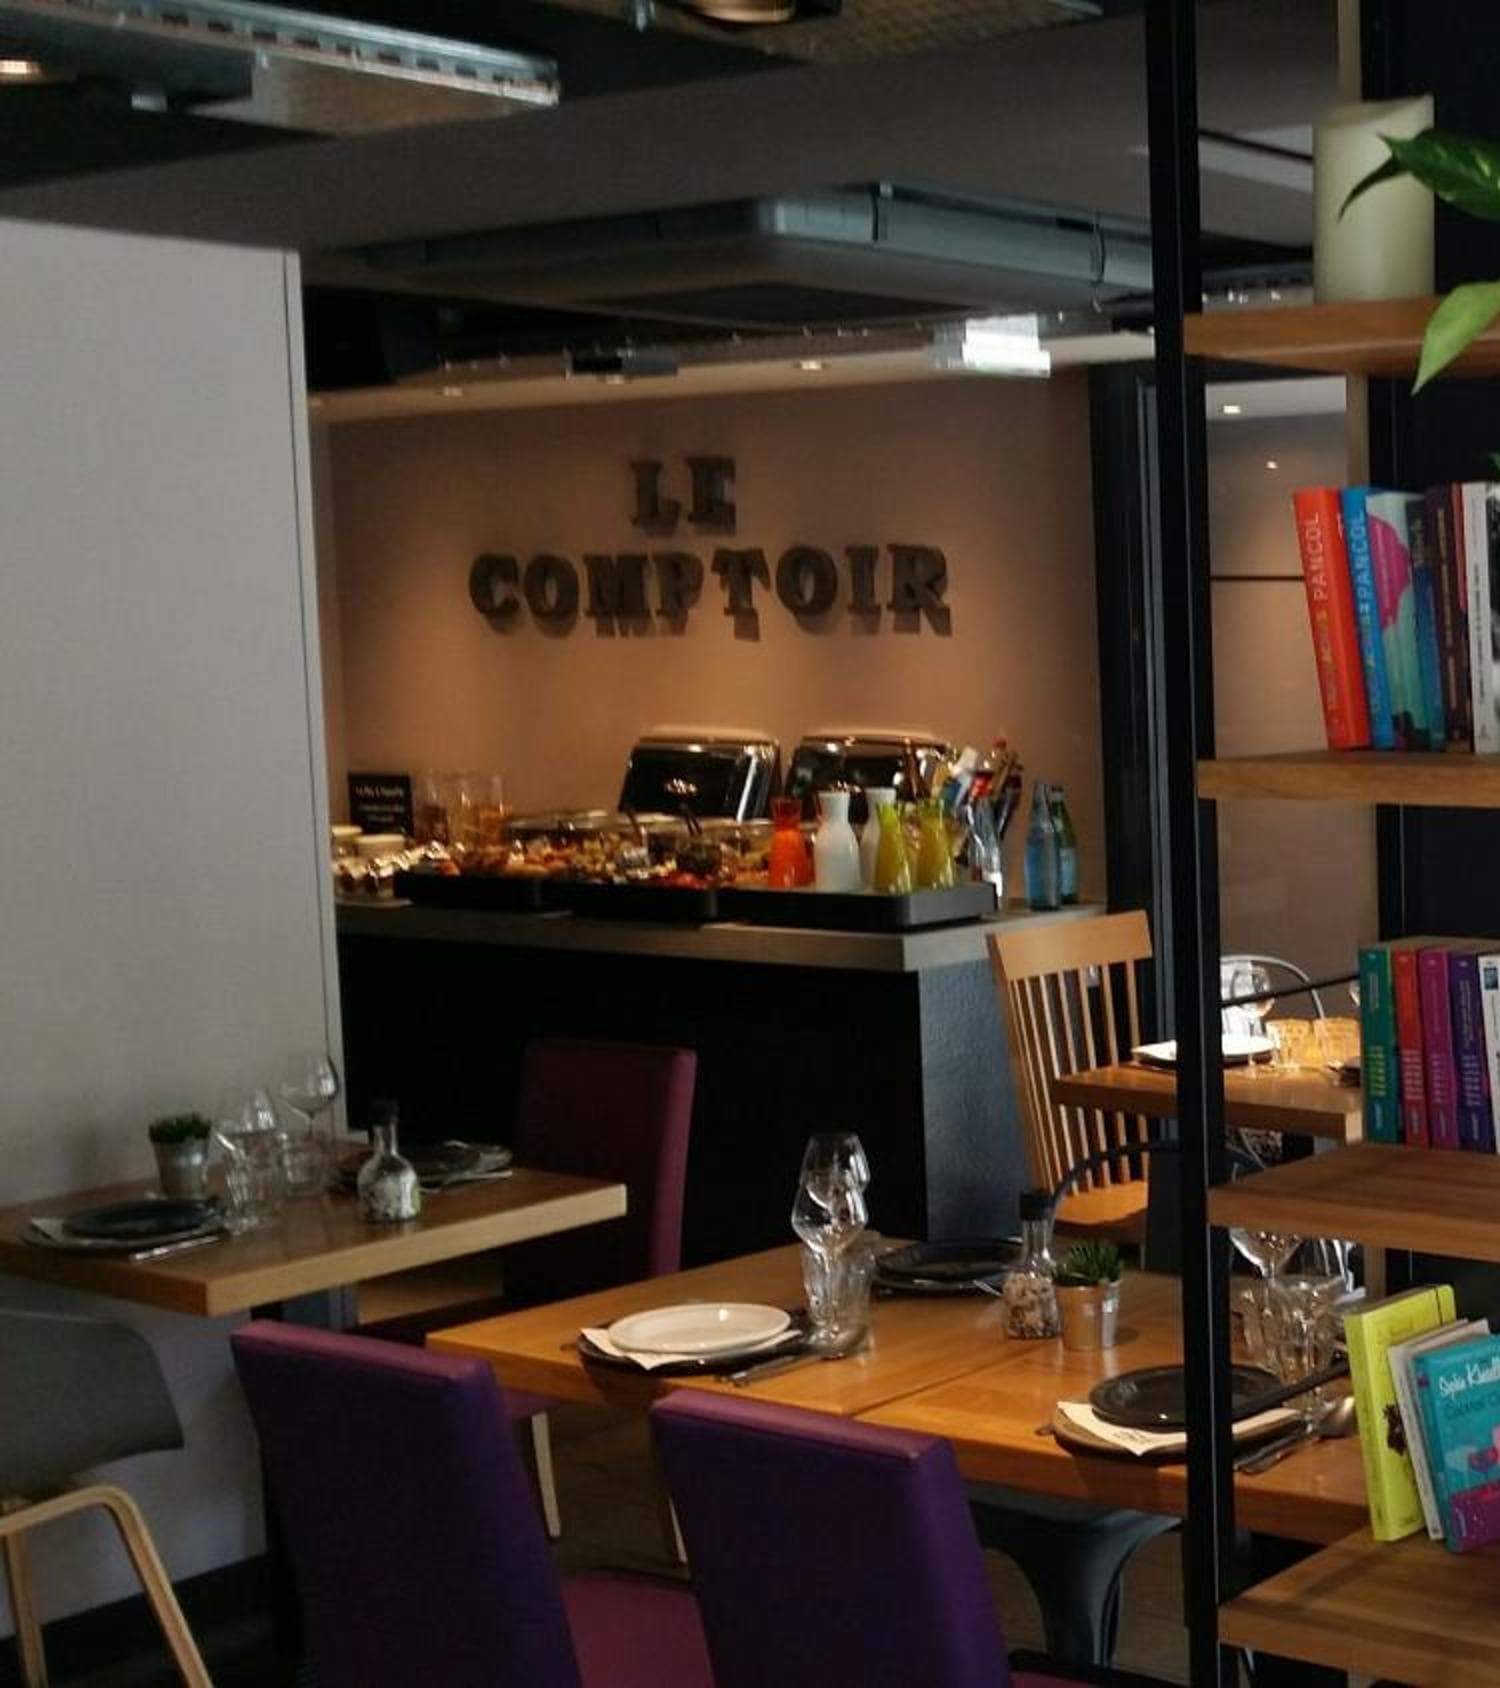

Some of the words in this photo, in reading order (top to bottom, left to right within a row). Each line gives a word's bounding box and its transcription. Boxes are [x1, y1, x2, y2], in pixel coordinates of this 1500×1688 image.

[629, 456, 737, 530] LE
[469, 544, 949, 626] COMPTOIR
[1304, 511, 1329, 601] PANCOL
[1350, 509, 1373, 600] PANCOL
